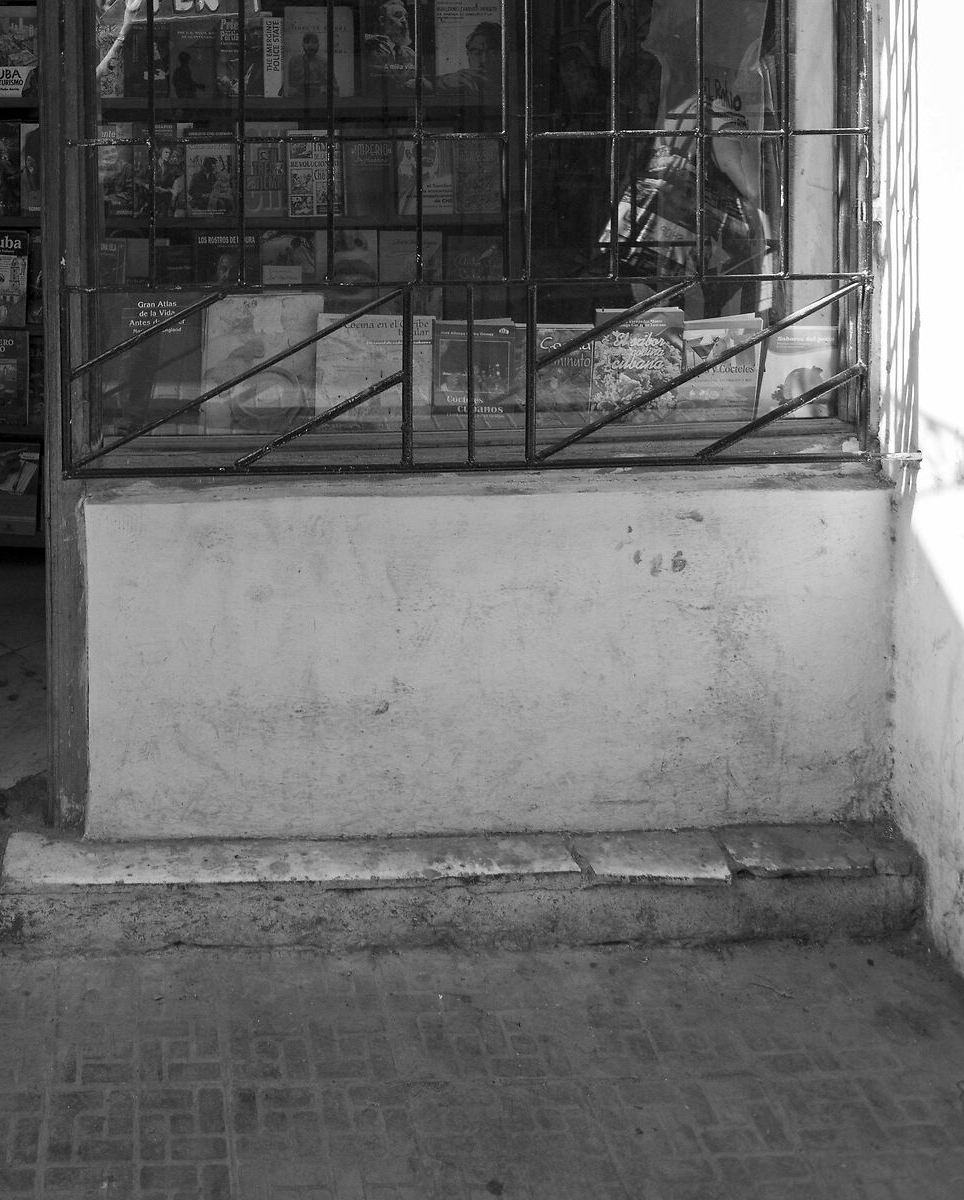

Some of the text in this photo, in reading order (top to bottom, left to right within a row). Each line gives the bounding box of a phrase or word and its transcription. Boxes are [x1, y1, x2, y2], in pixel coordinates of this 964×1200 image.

[198, 236, 207, 244] LOS
[157, 300, 177, 308] Atlas
[390, 320, 398, 329] el
[399, 320, 429, 329] Cibe
[398, 328, 428, 336] Iular
[540, 336, 591, 351] Coa
[611, 354, 666, 370] cubana
[719, 364, 755, 374] Cocteles
[447, 396, 484, 404] Coctles
[457, 405, 504, 413] cuanos
